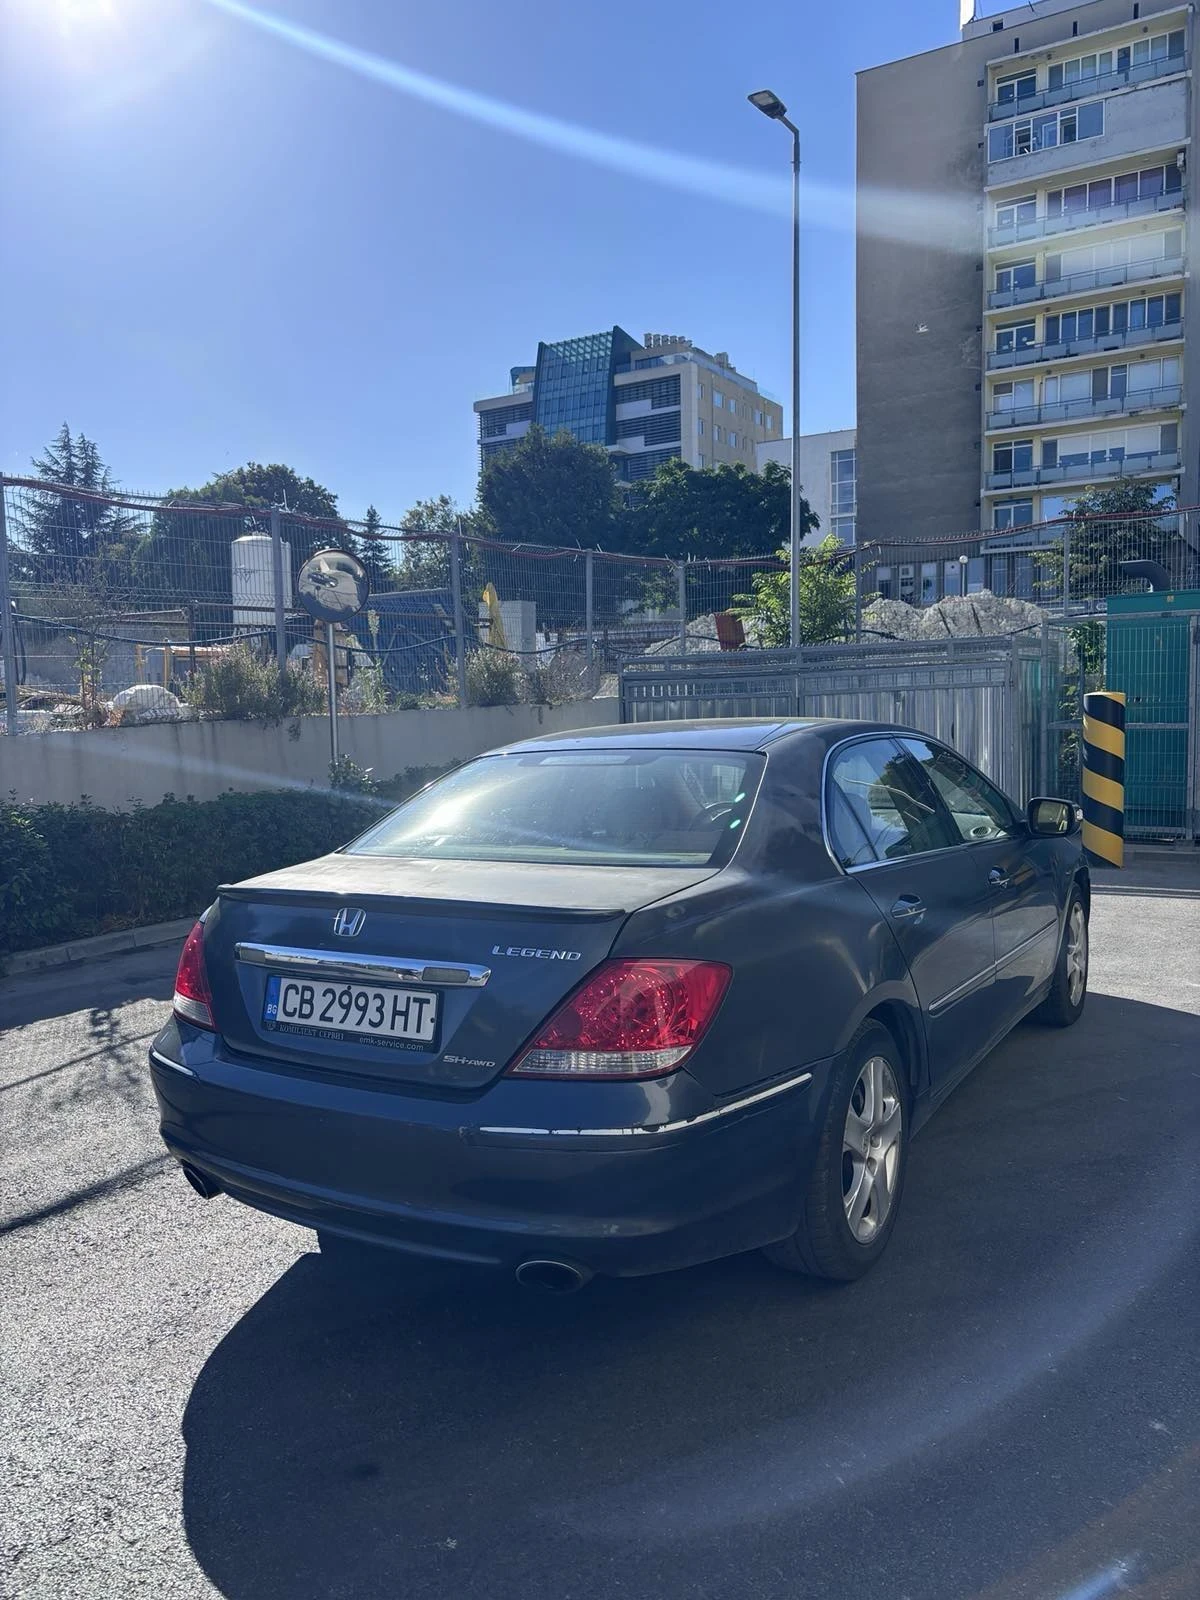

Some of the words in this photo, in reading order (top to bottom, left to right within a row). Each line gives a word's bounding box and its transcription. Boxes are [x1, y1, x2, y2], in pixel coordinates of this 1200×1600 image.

[491, 945, 582, 961] LEGEND
[266, 1003, 277, 1015] BG
[282, 983, 315, 1019] CB
[319, 987, 386, 1029] 2993
[390, 995, 431, 1033] HT
[359, 1036, 424, 1052] emk-service.com
